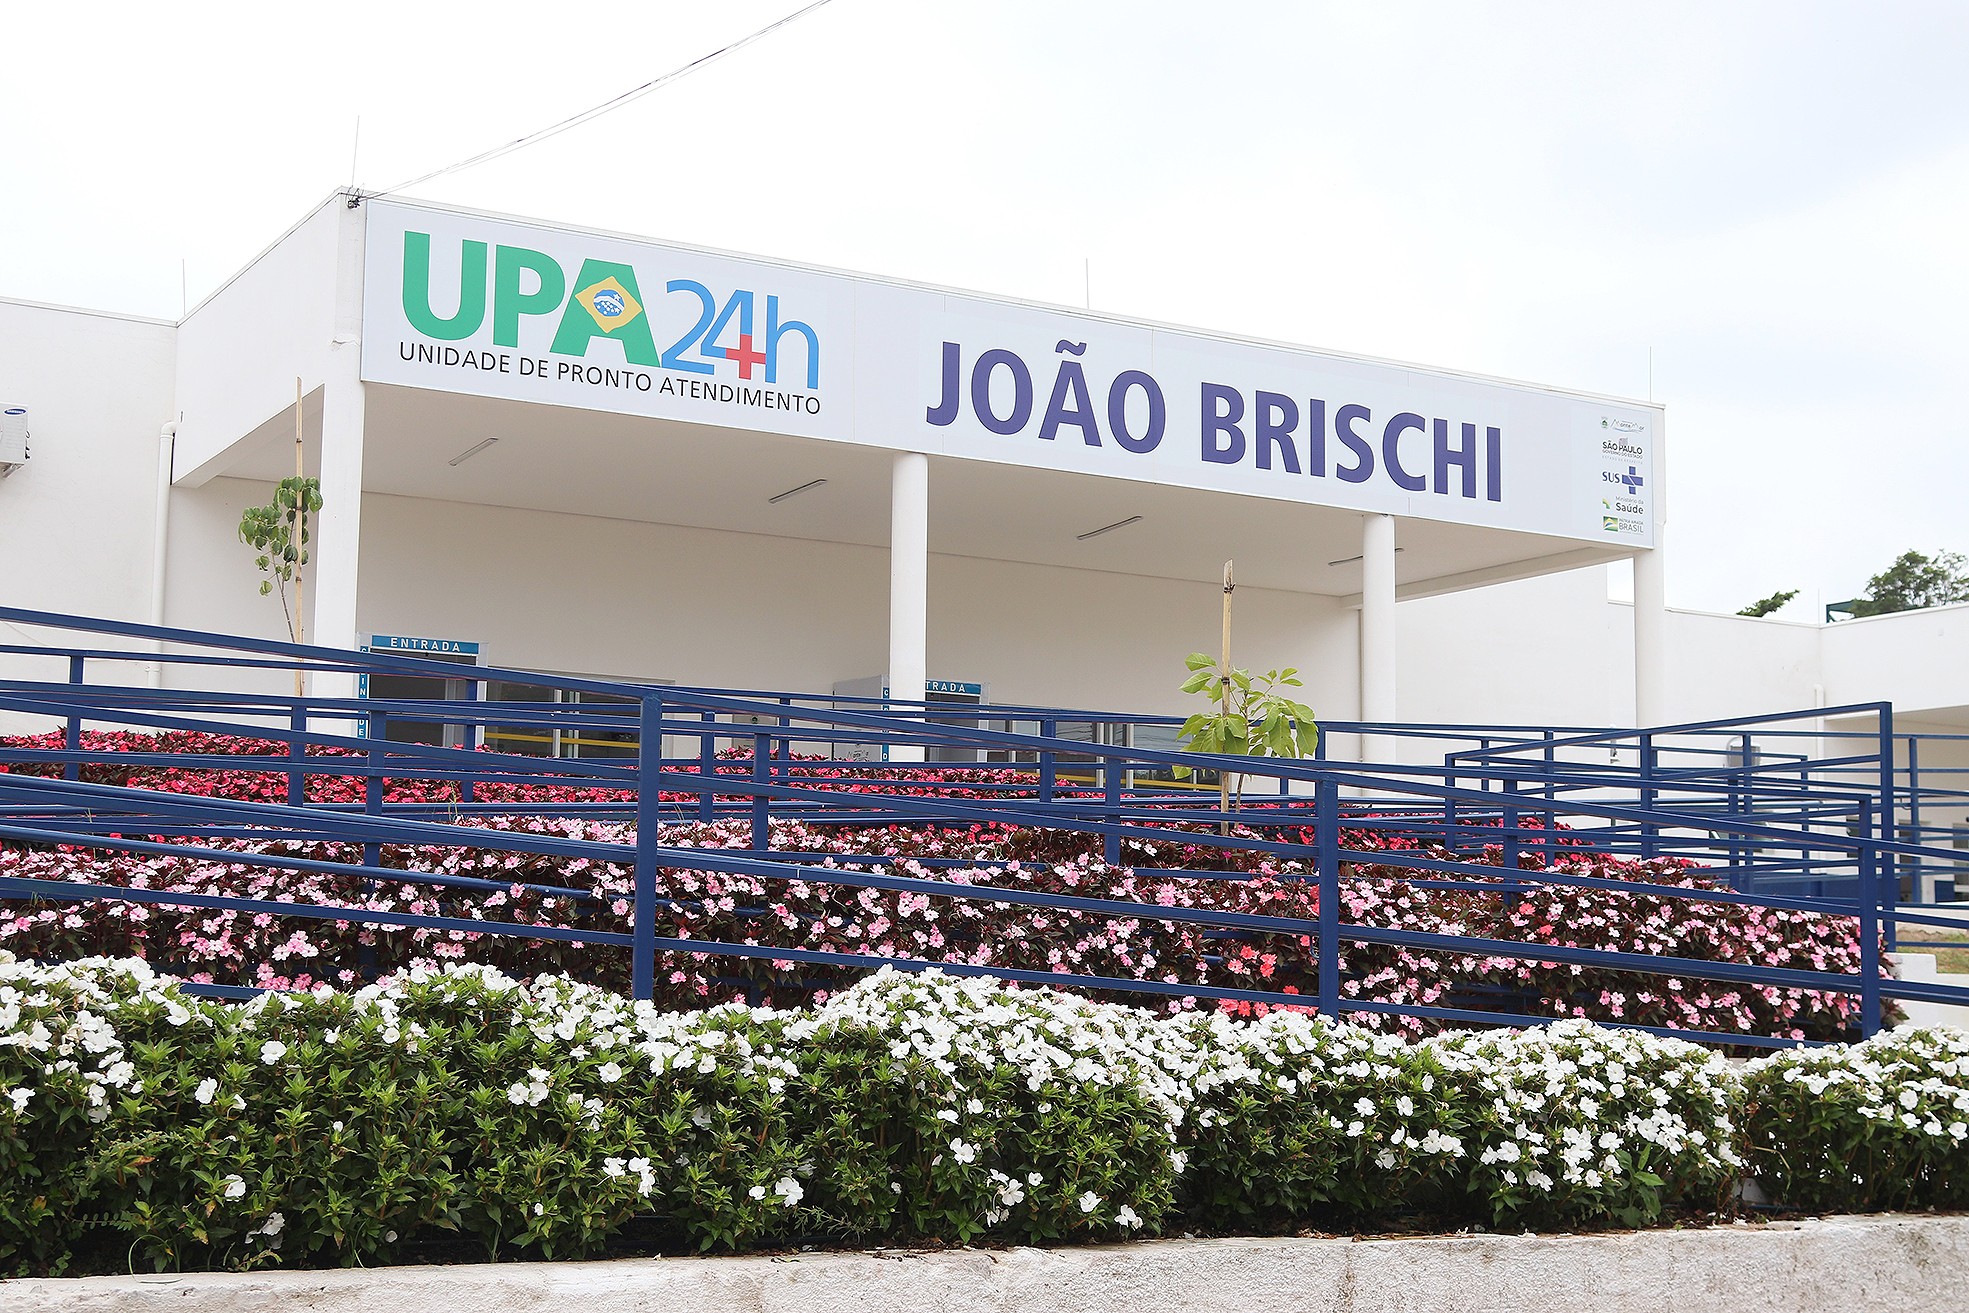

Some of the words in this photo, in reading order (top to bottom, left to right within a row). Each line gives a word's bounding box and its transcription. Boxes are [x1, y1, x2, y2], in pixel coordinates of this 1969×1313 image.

[402, 230, 661, 368] UPA
[661, 278, 820, 390] 24h
[399, 341, 511, 373] UNIDADE
[519, 357, 550, 379] DE
[557, 362, 652, 392] PRONTO
[659, 377, 821, 415] ATENDIMENTO
[925, 338, 1167, 455] JOÃO
[1200, 381, 1502, 503] BRISCHI
[1602, 440, 1618, 451] SÃO
[1619, 445, 1643, 455] PAULO
[1602, 471, 1620, 484] SUS
[1615, 502, 1644, 515] Saúde
[1618, 522, 1644, 533] BRASIL
[390, 637, 461, 652] ENTRADA
[926, 680, 966, 693] TRADA
